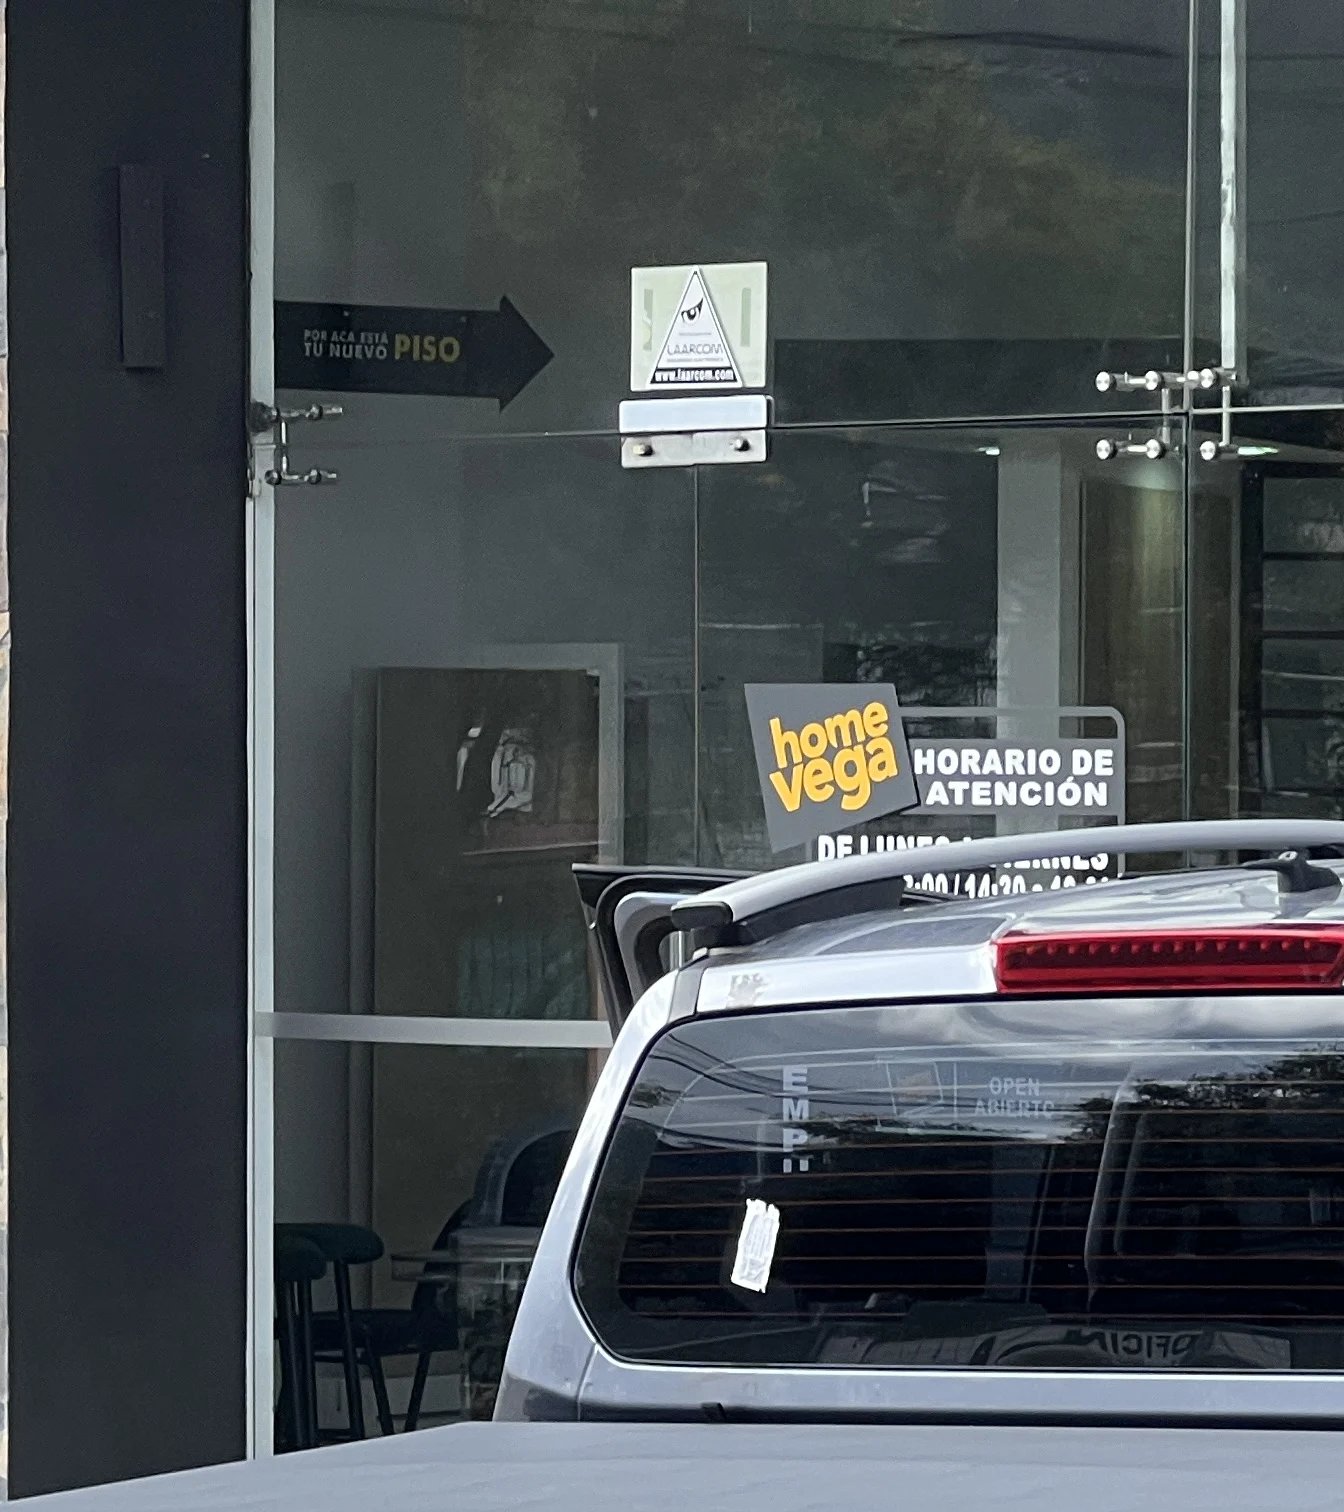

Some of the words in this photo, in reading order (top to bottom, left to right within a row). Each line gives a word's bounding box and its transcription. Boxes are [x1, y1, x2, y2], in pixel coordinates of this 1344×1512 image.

[303, 329, 327, 341] POR
[304, 343, 324, 357] TU
[329, 343, 388, 360] NUEVO
[394, 333, 461, 363] PISO
[666, 343, 724, 356] LAARCOM
[654, 369, 734, 382] www.laarcom.com
[769, 701, 889, 768] home
[769, 737, 899, 813] vega
[913, 748, 1061, 776] HORARIO
[1072, 749, 1114, 776] DE
[925, 776, 1108, 807] ATENCIÓN
[989, 1076, 1040, 1096] OPEN
